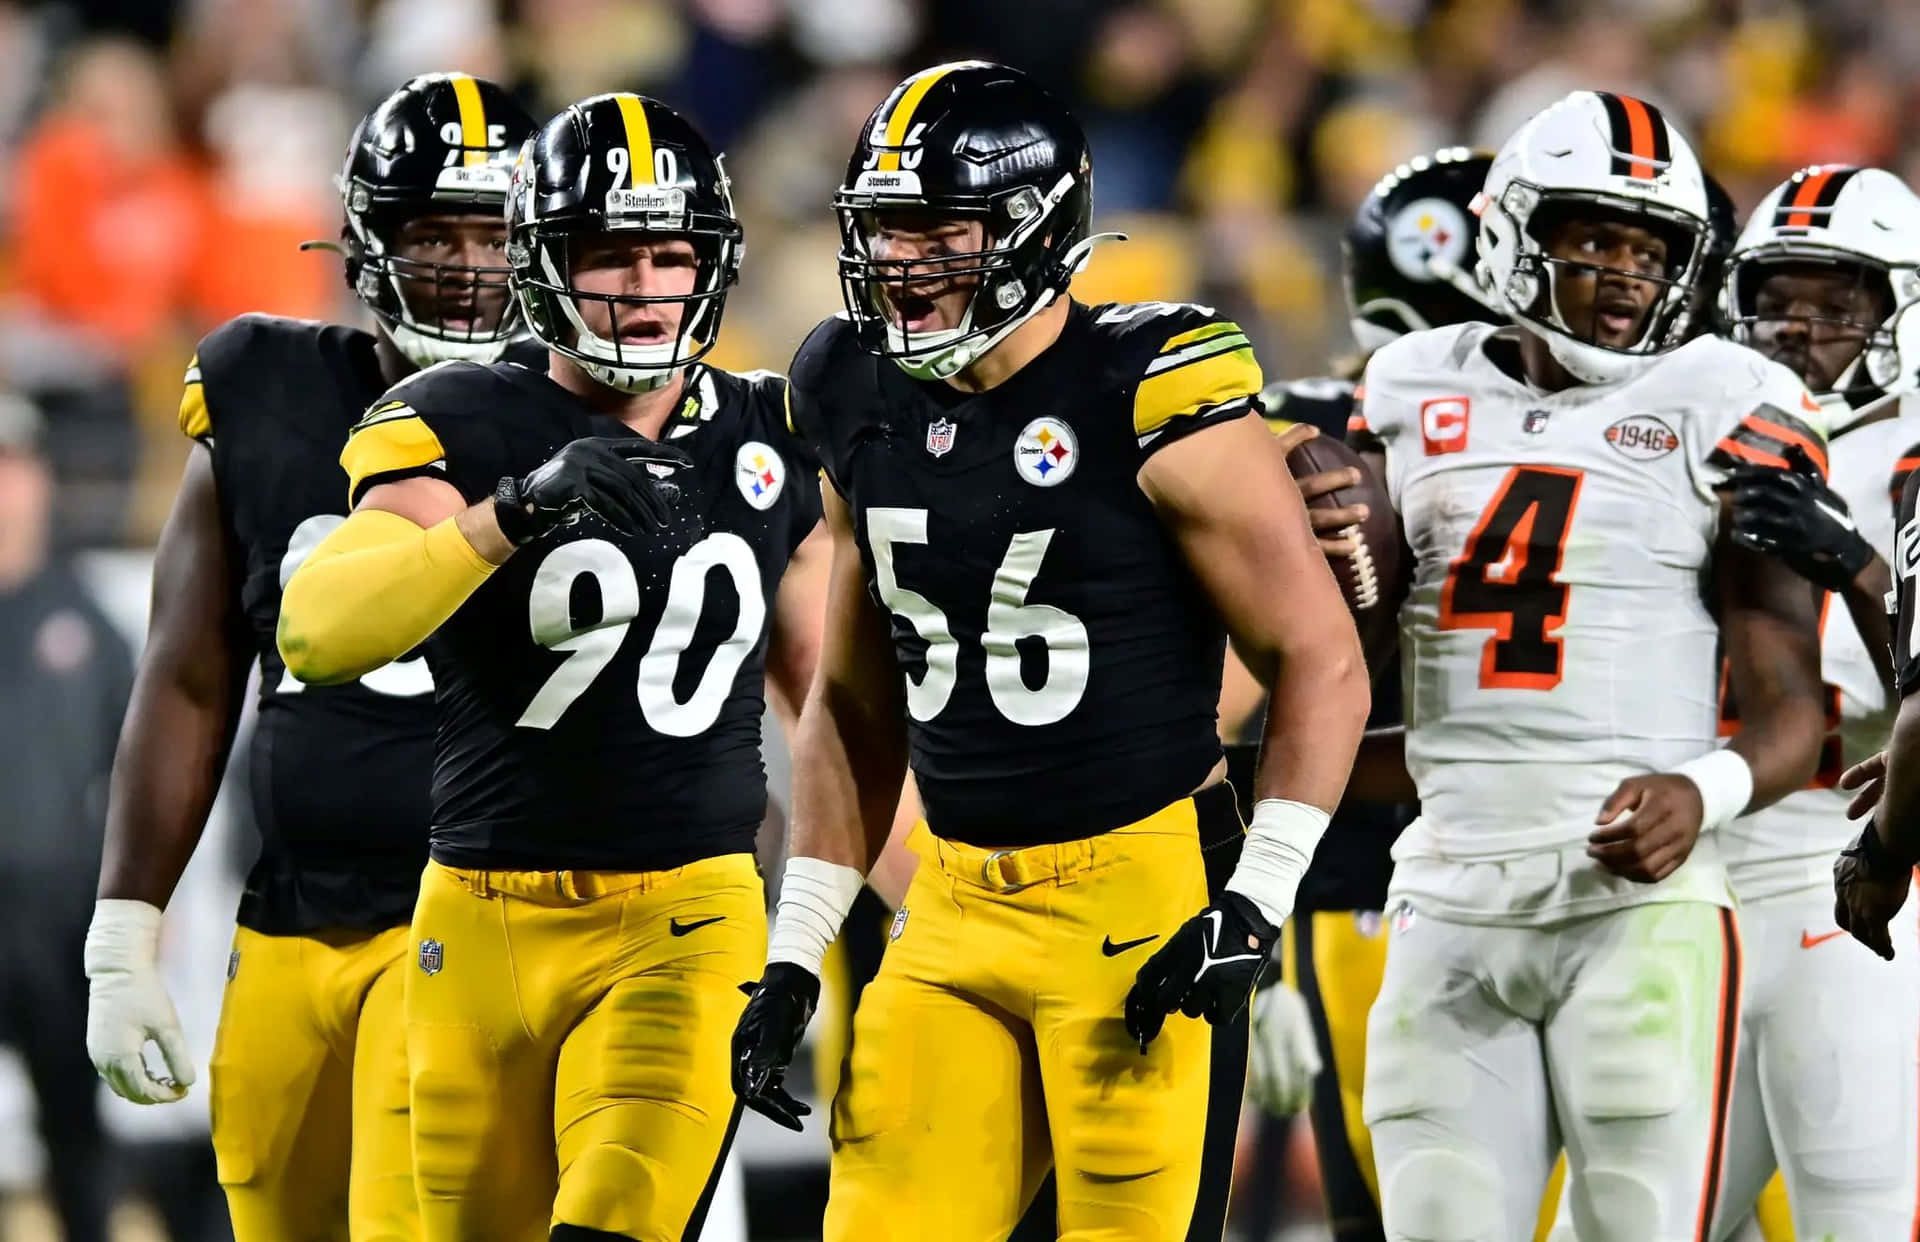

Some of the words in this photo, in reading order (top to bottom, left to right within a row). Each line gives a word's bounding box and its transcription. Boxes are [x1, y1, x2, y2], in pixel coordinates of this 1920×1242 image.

[606, 147, 678, 190] 90
[867, 174, 900, 187] Steelers
[625, 193, 665, 209] Steelers
[1423, 401, 1467, 440] C
[1618, 424, 1665, 451] 1946
[1438, 463, 1585, 691] 4
[515, 532, 766, 737] 90
[866, 507, 1090, 726] 56
